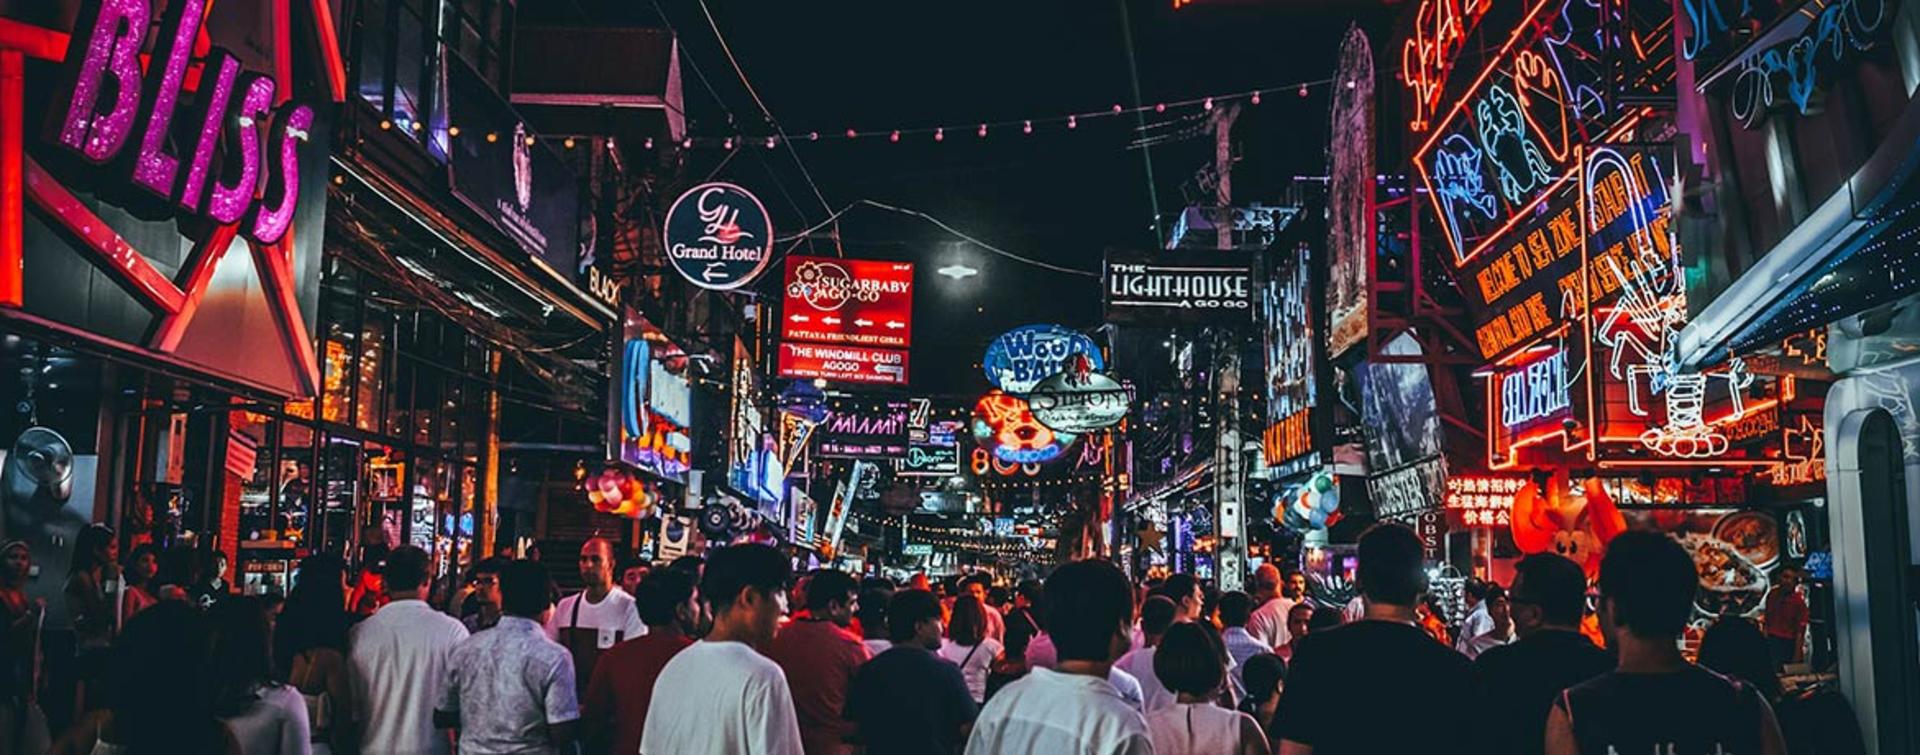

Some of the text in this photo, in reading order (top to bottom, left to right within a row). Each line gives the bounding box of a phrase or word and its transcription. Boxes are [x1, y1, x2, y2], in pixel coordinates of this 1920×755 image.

[60, 0, 315, 246] BLISS
[672, 243, 762, 261] Grand Hotel
[1511, 242, 1533, 280] TO
[1526, 228, 1555, 270] SEA
[1547, 207, 1582, 259] ZONE
[1110, 263, 1145, 273] THE
[821, 276, 910, 293] SUGARBABY
[1110, 274, 1248, 298] LIGHTHOUSE
[1178, 299, 1248, 309] A GO GO
[789, 330, 828, 341] PATTAYA
[791, 346, 902, 364] THE WINDMILL CLUB
[822, 361, 860, 371] AGOGO
